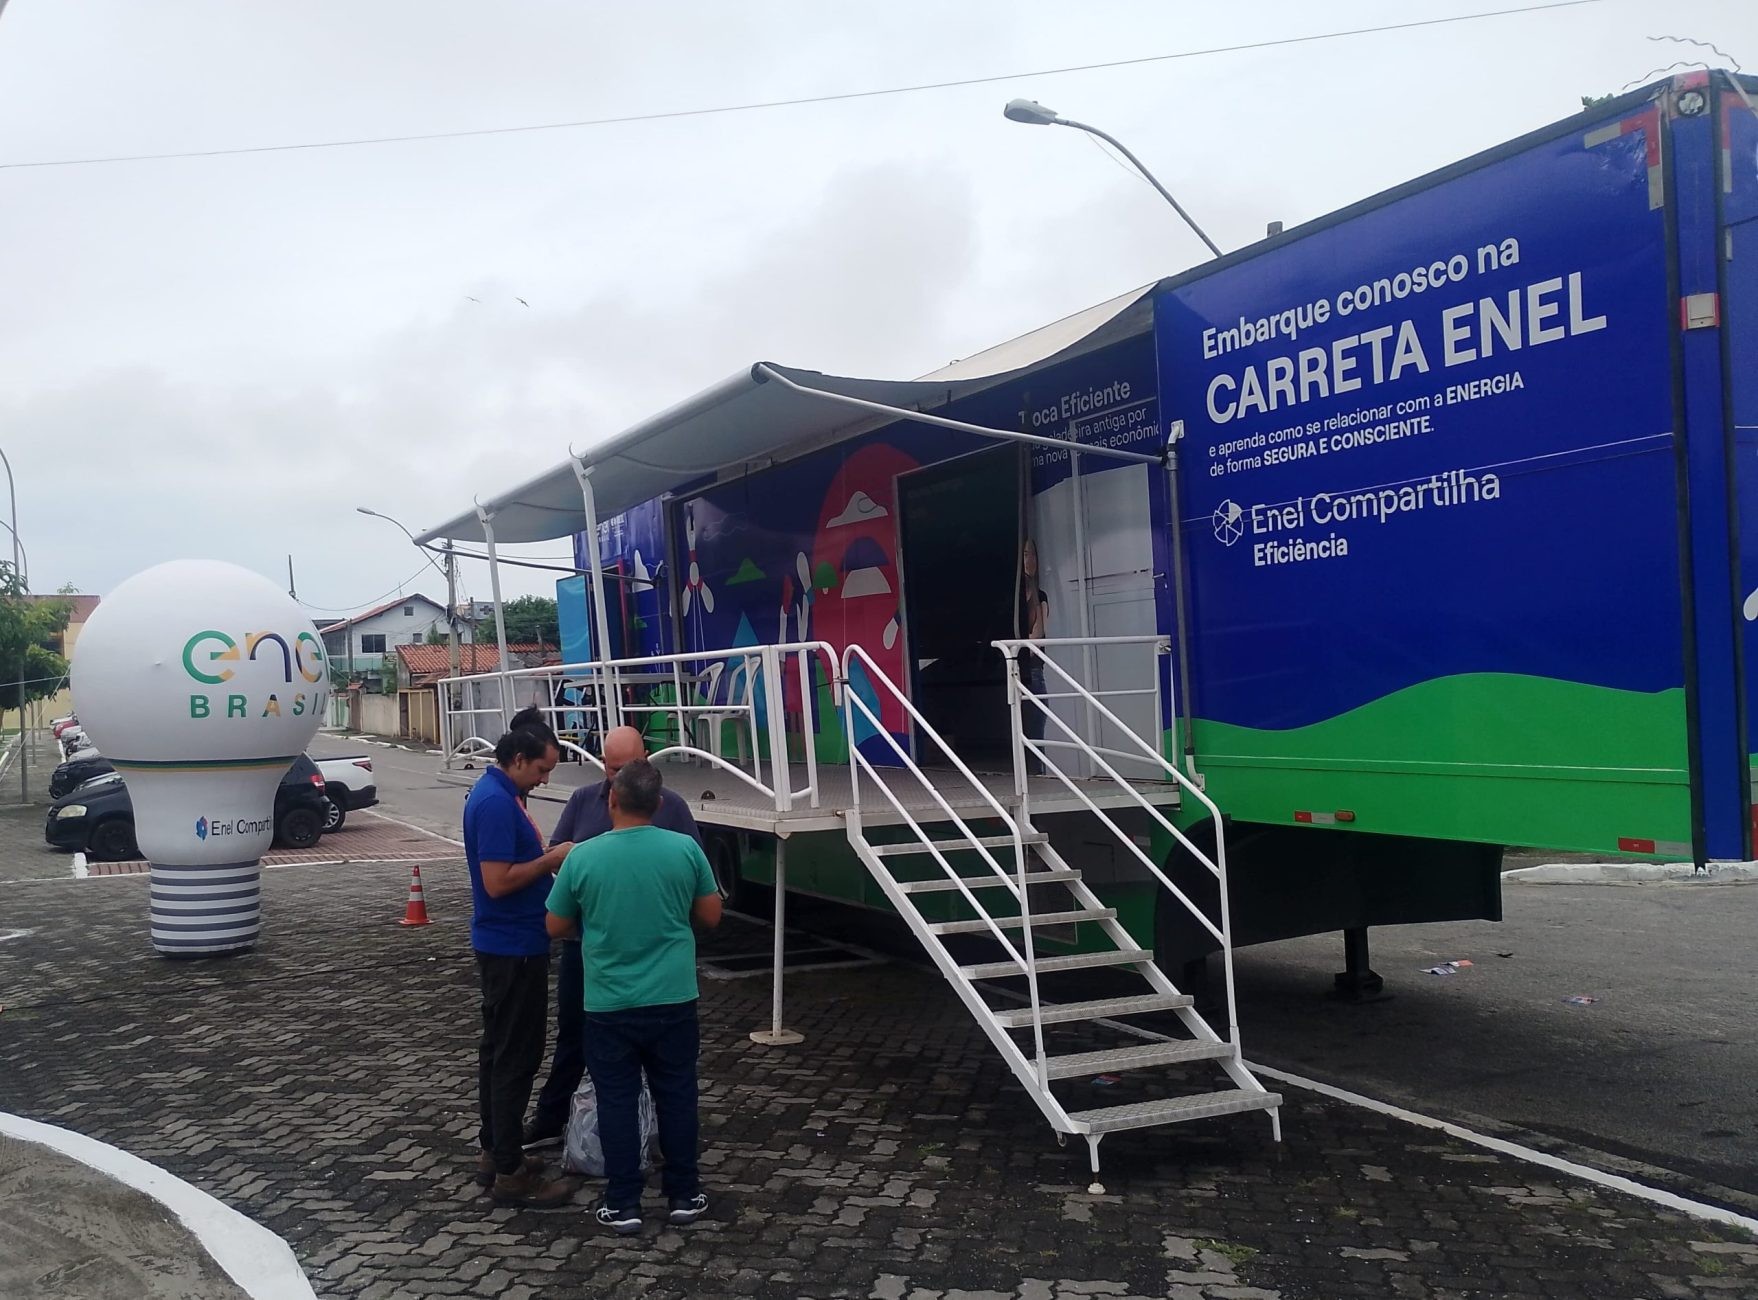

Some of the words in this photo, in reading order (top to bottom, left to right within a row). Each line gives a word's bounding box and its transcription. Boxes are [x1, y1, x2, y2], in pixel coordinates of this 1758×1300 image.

[1203, 298, 1330, 359] Embarque
[1337, 254, 1469, 317] conosco
[1477, 237, 1519, 274] na
[1206, 319, 1430, 424] CARRETA
[1443, 271, 1607, 367] ENEL
[1018, 406, 1058, 427] Toca
[1061, 381, 1131, 418] Eficiente
[1093, 414, 1126, 433] antiga
[1128, 408, 1146, 428] por
[1209, 446, 1216, 457] e
[1218, 433, 1266, 457] aprenda
[1269, 425, 1303, 443] como
[1306, 421, 1320, 435] se
[1324, 405, 1393, 431] relacionar
[1397, 396, 1430, 415] com
[1434, 393, 1443, 407] a
[1446, 371, 1525, 405] ENERGIA
[1046, 449, 1068, 464] nova
[1210, 461, 1224, 477] de
[1227, 456, 1261, 474] forma
[1263, 441, 1317, 466] SEGURA
[1319, 437, 1328, 454] E
[1331, 415, 1434, 451] CONSCIENTE.
[1251, 496, 1304, 535] Enel
[1310, 469, 1500, 523] Compartilha
[1253, 532, 1348, 567] Eficiência
[212, 820, 233, 836] Enel
